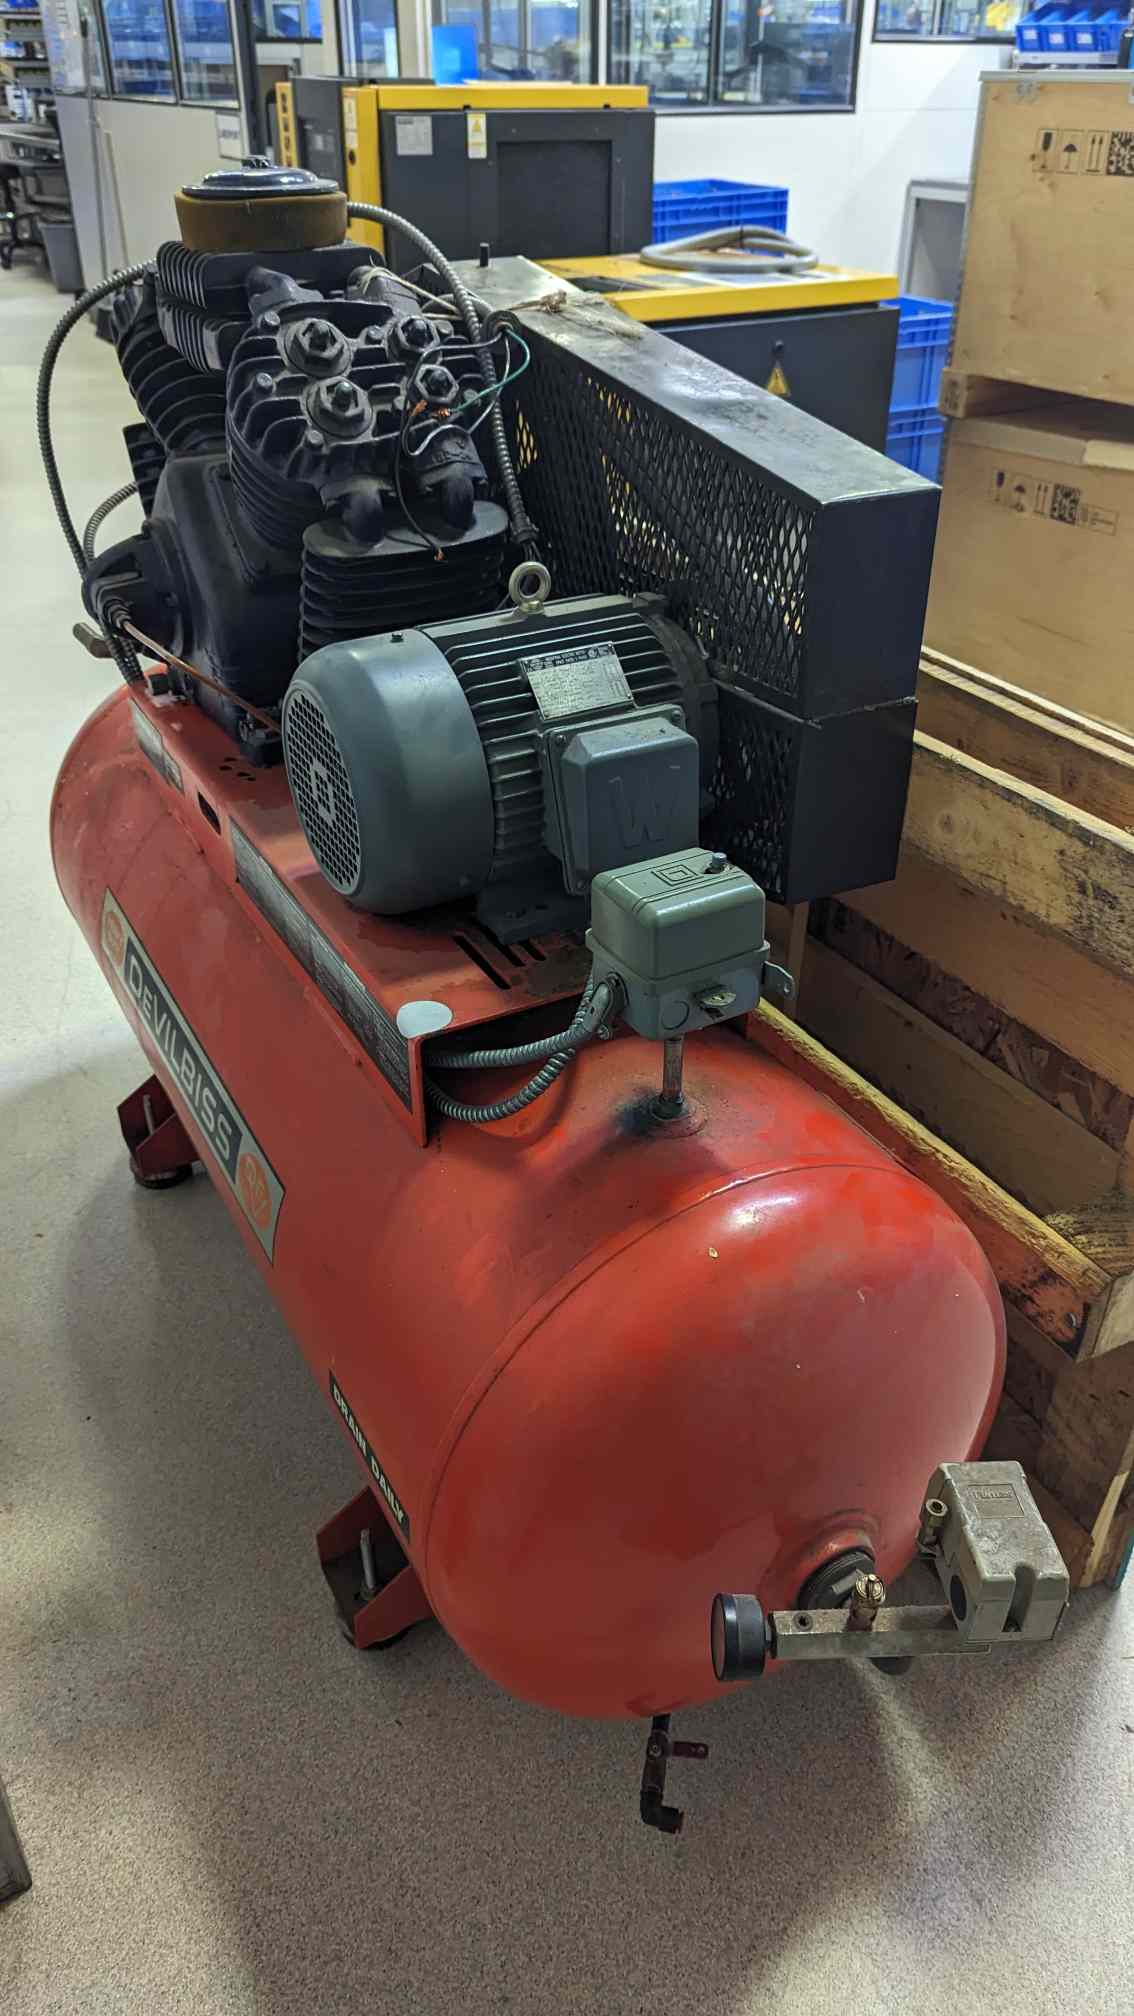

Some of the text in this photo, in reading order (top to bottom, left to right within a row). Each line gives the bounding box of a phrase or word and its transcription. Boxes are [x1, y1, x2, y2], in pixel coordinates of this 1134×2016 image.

[128, 953, 233, 1161] DEVILBISS
[333, 1383, 404, 1524] DRAIN DAILY
